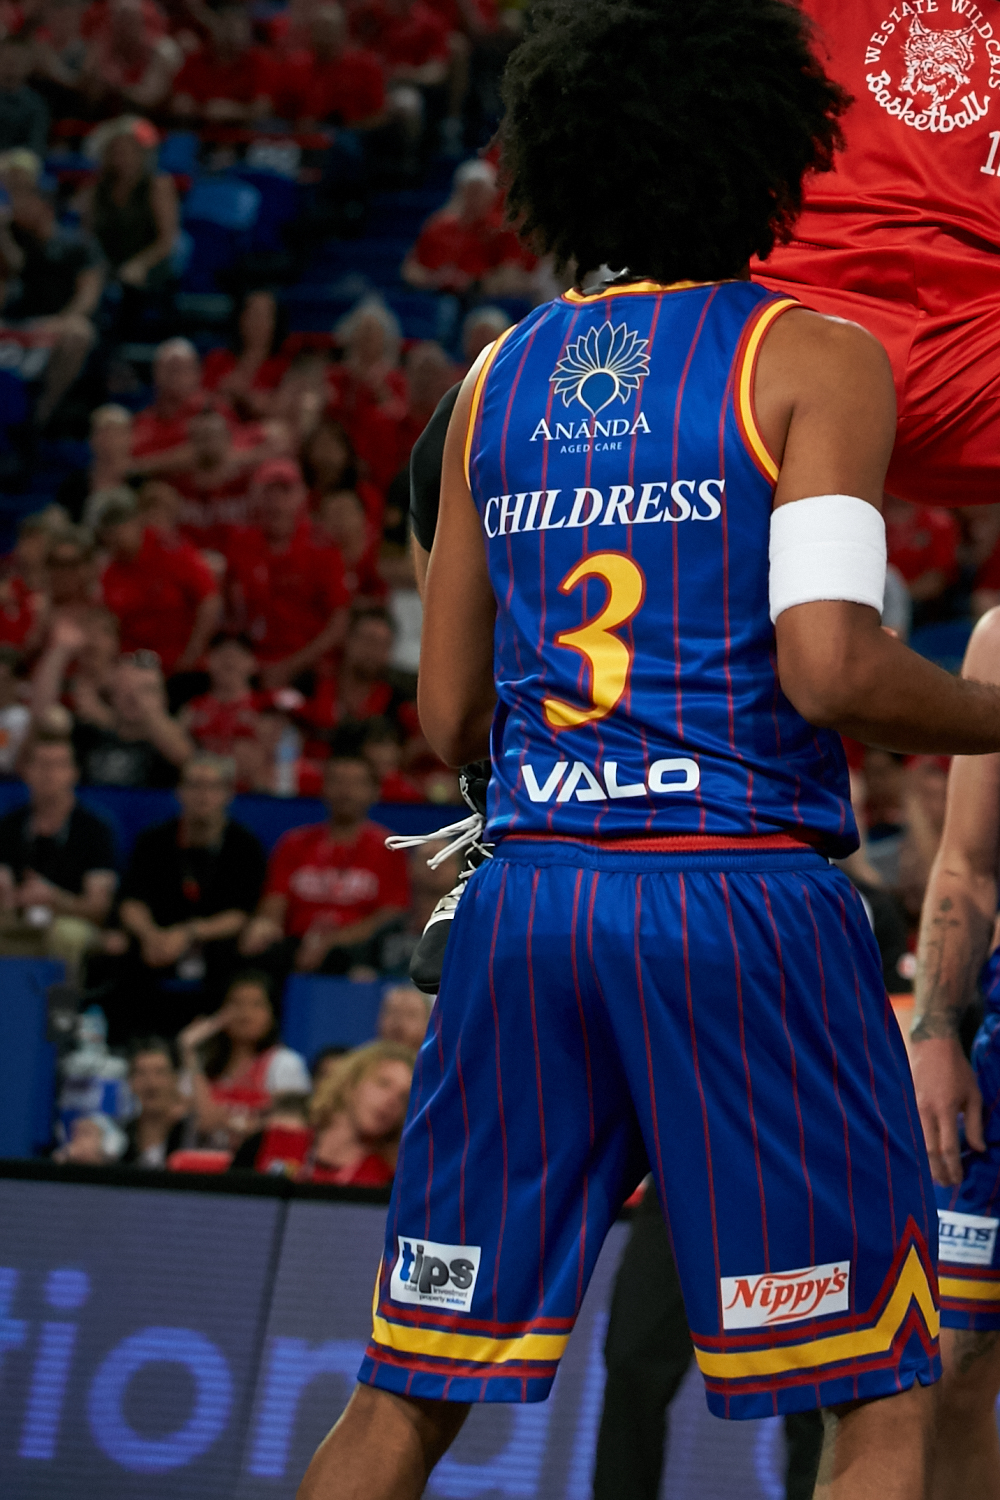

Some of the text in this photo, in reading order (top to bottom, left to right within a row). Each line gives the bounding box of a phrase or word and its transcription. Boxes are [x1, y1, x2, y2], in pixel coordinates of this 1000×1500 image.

[866, 69, 991, 133] Basketball
[560, 441, 623, 454] AGED CARE
[484, 478, 726, 539] CHILDRESS
[543, 550, 646, 731] 3
[520, 757, 701, 802] VALO
[399, 1241, 475, 1294] tips
[725, 1266, 848, 1325] Nippy's
